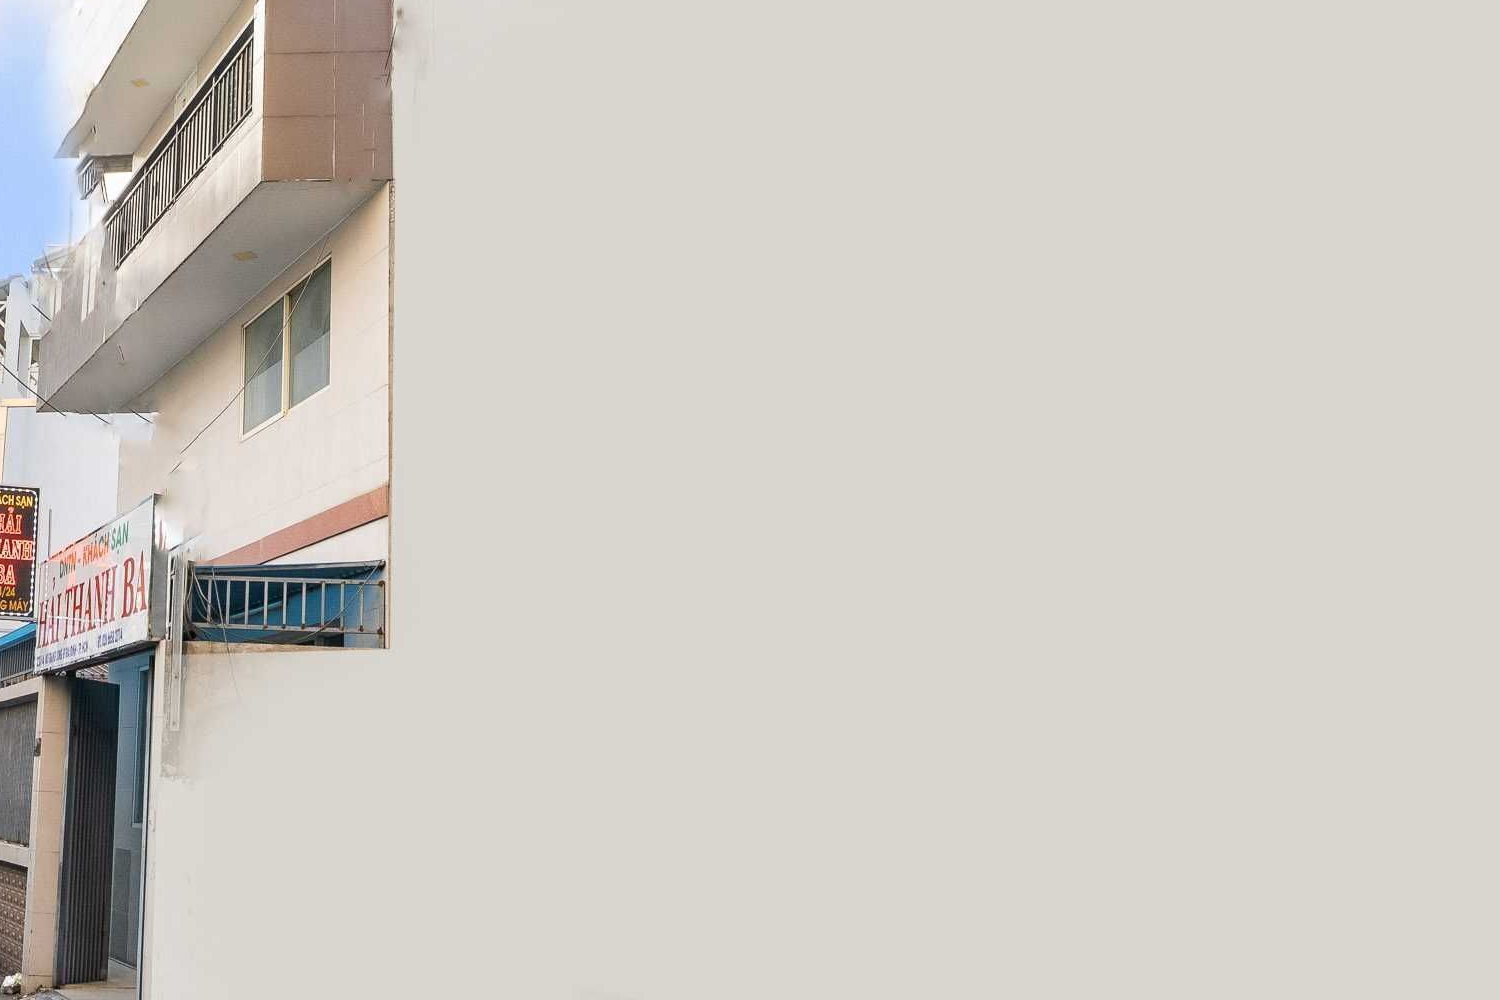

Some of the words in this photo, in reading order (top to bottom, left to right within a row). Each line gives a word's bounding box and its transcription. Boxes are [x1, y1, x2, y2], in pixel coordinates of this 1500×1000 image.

[15, 495, 33, 509] SẠN
[82, 531, 110, 567] KHÁCH
[111, 521, 129, 554] SẠN
[9, 597, 29, 611] MÁY
[63, 565, 118, 638] THANH
[121, 549, 148, 618] BA
